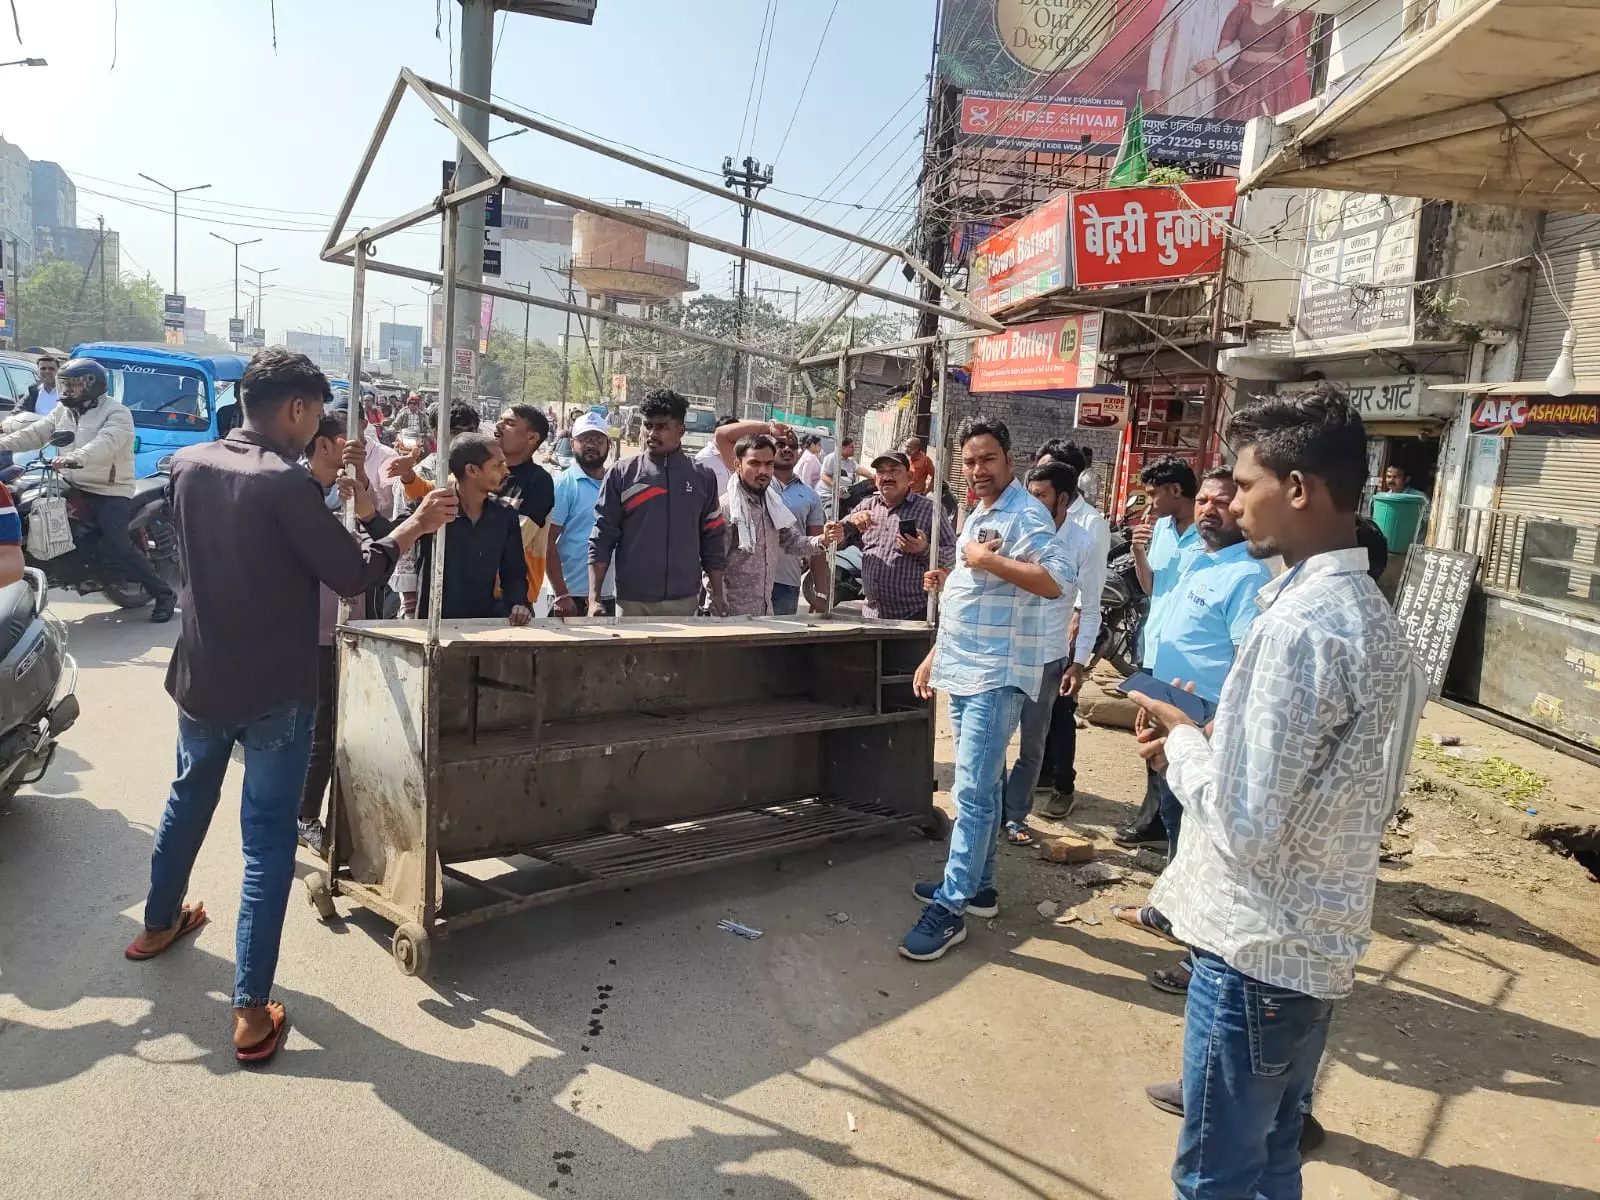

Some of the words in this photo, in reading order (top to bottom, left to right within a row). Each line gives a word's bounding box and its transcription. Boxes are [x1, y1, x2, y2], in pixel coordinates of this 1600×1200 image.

[1034, 7, 1074, 34] Our
[1012, 27, 1090, 56] Designs
[1060, 114, 1118, 128] SHIVAM
[1017, 223, 1060, 265] Battery
[978, 337, 1008, 363] Mowa
[1010, 328, 1057, 363] Battery
[121, 363, 158, 374] Noor
[1376, 377, 1415, 411] आर्ट
[1478, 400, 1527, 423] AFC
[1528, 404, 1598, 422] ASHAPURA
[1413, 551, 1438, 611] गजवानी
[1427, 554, 1453, 611] गजवानी
